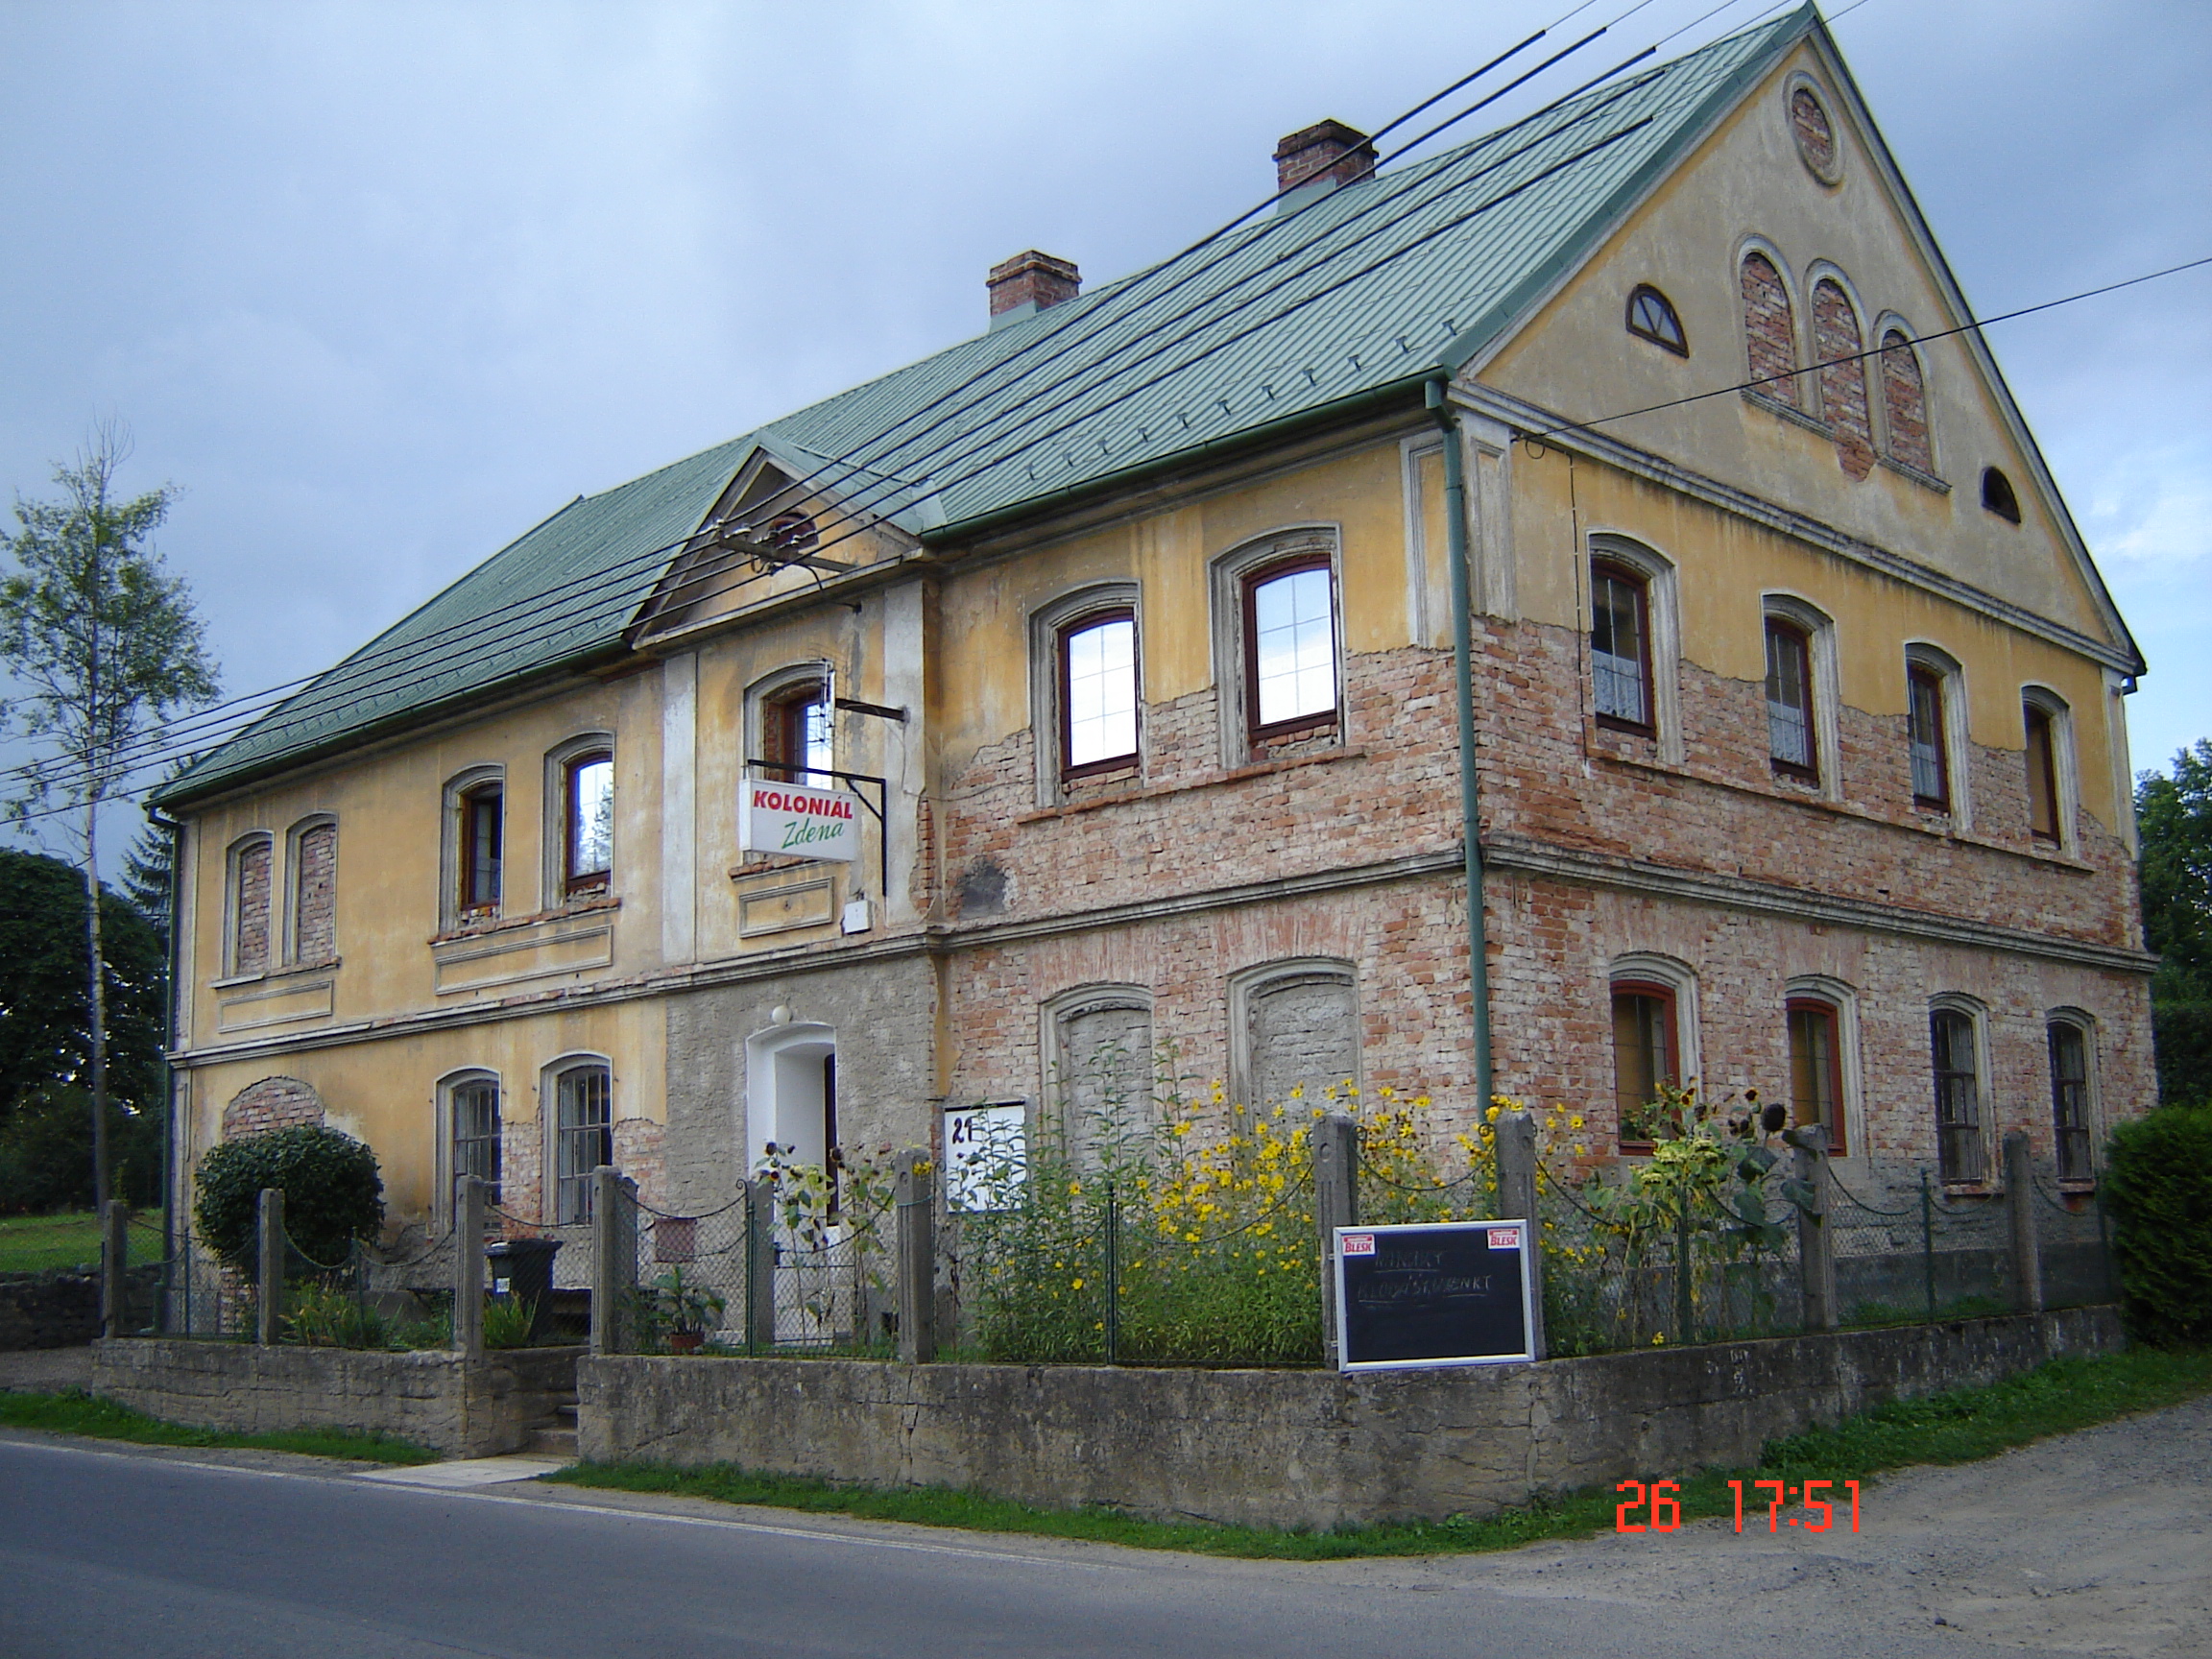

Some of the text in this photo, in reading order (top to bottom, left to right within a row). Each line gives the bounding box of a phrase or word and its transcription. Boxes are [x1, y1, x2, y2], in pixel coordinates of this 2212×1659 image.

[754, 790, 853, 819] KOLONIÁL
[781, 818, 844, 849] Zdena
[1344, 1241, 1373, 1253] BLESK
[1490, 1235, 1518, 1246] BLESK
